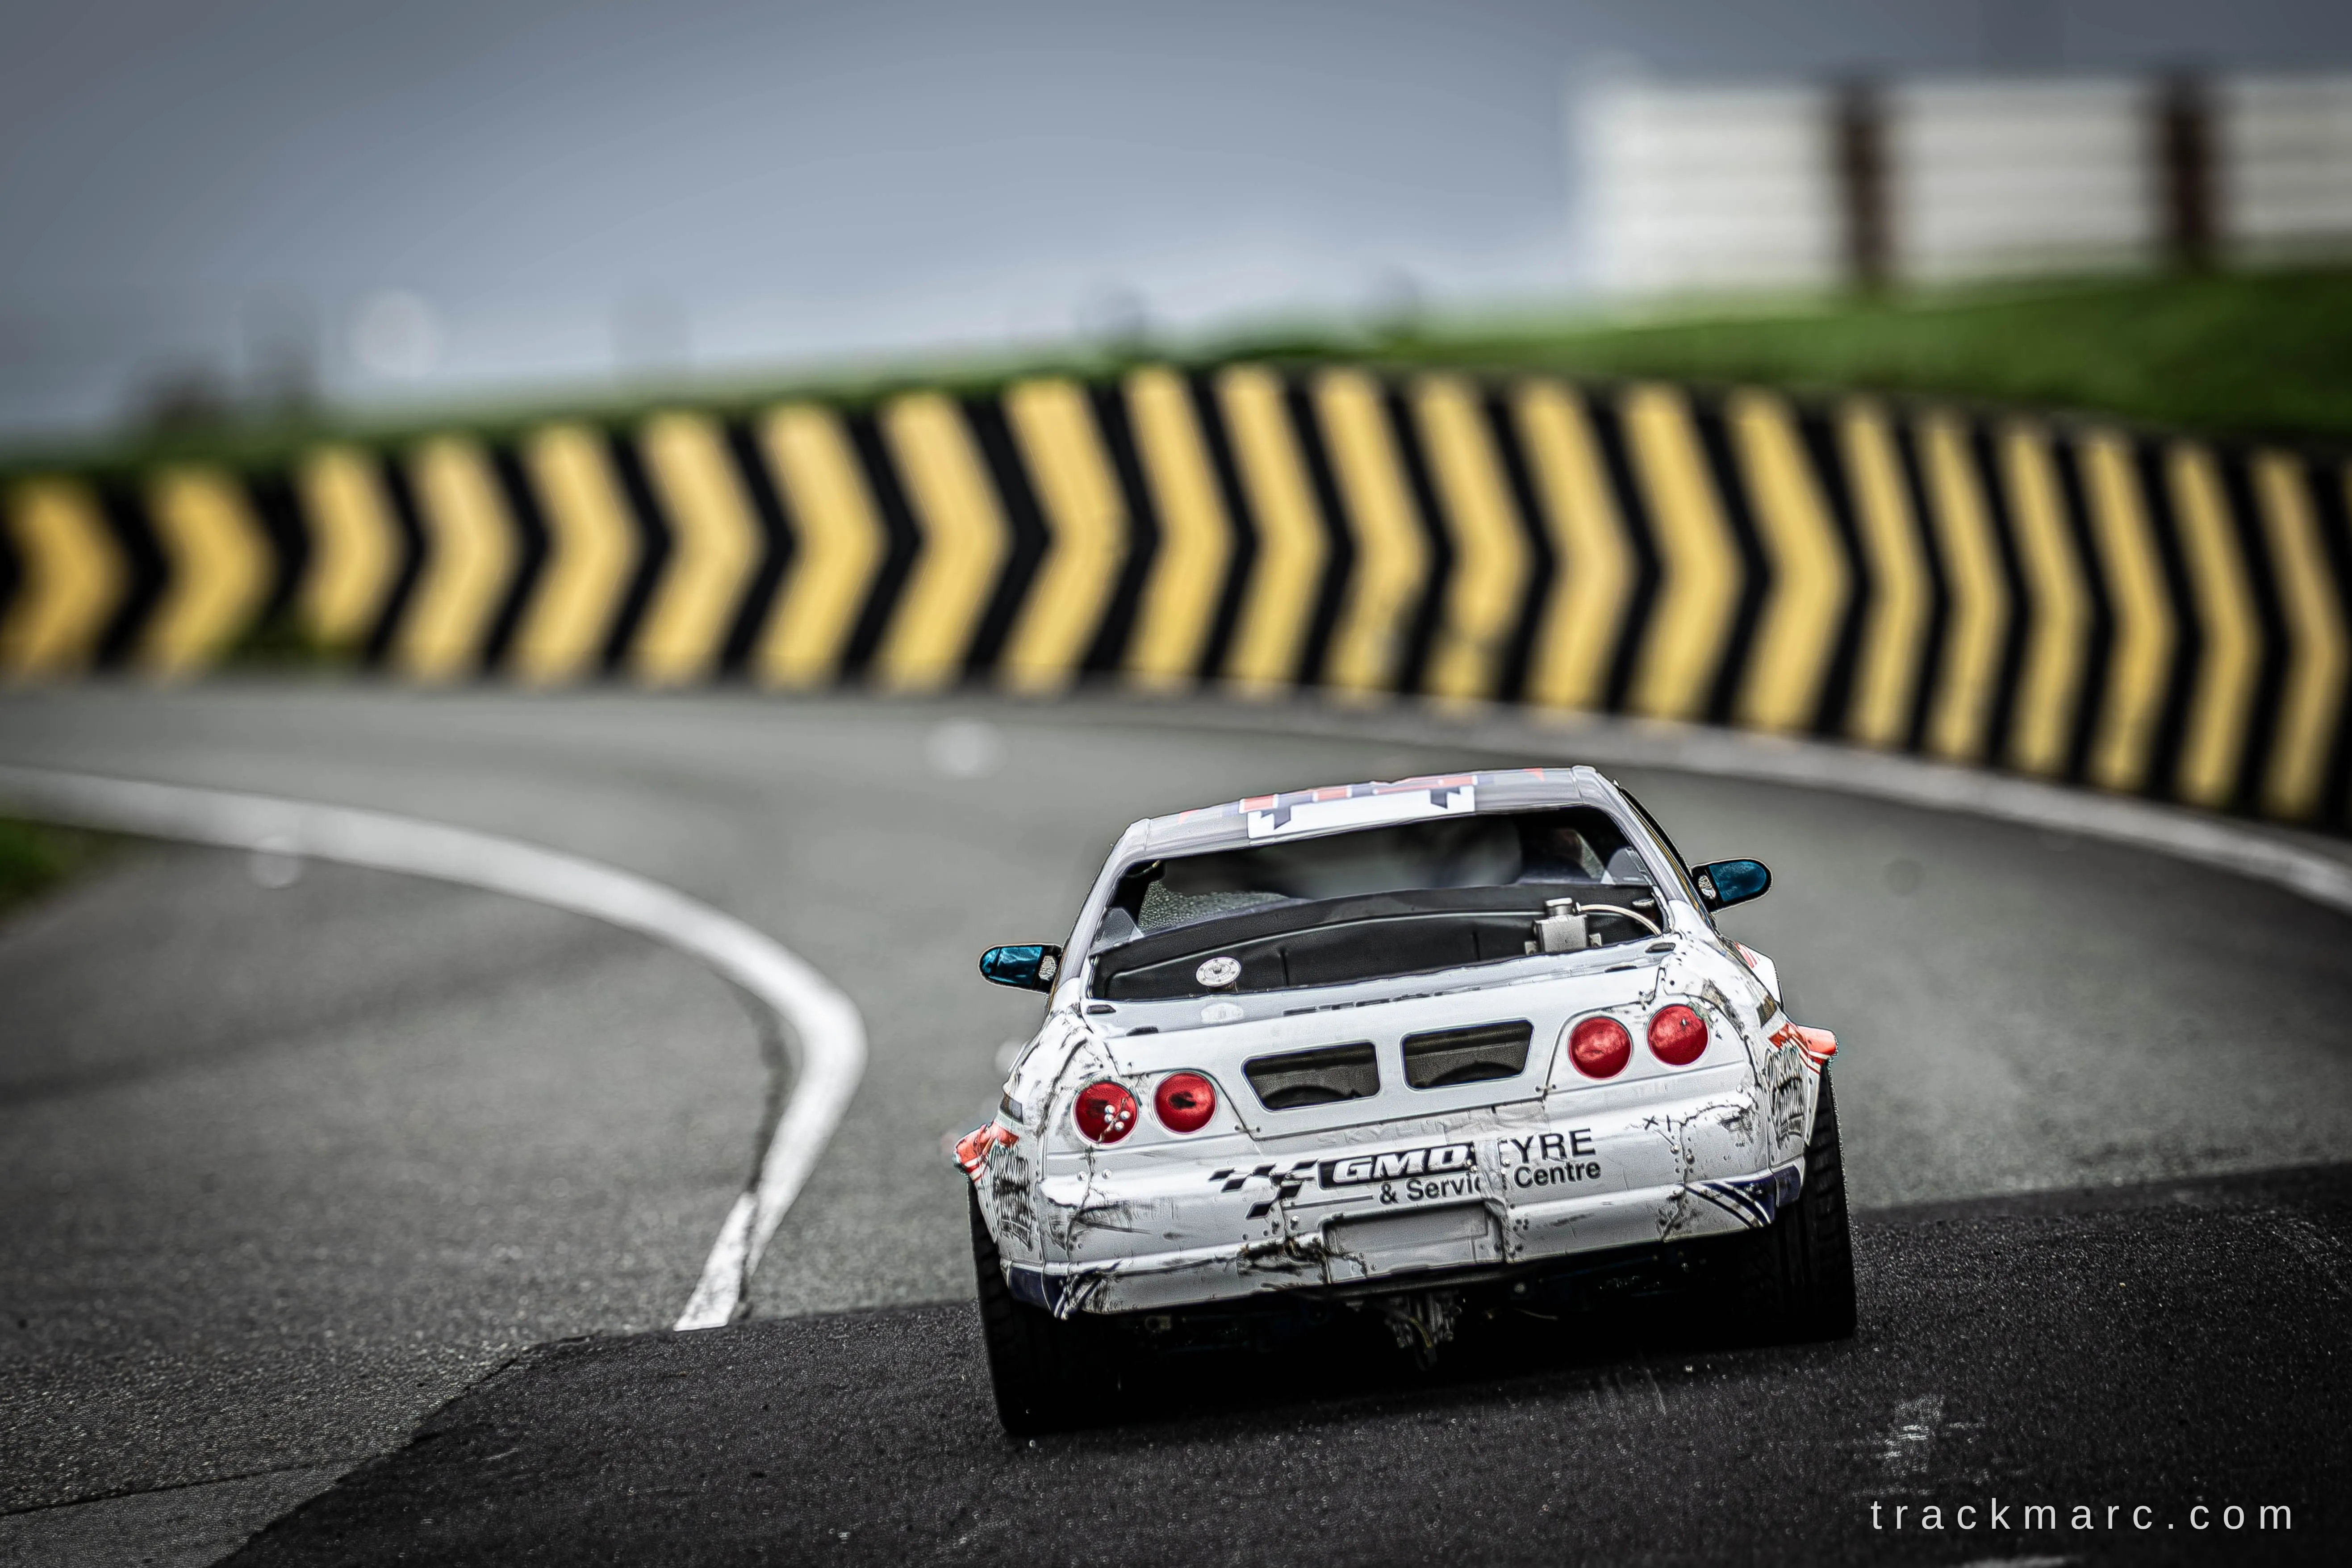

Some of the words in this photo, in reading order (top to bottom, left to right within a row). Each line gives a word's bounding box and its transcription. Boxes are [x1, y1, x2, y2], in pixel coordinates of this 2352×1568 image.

[1379, 1182, 1399, 1204] &
[1406, 1172, 1481, 1201] Servi
[1514, 1161, 1600, 1188] Centre
